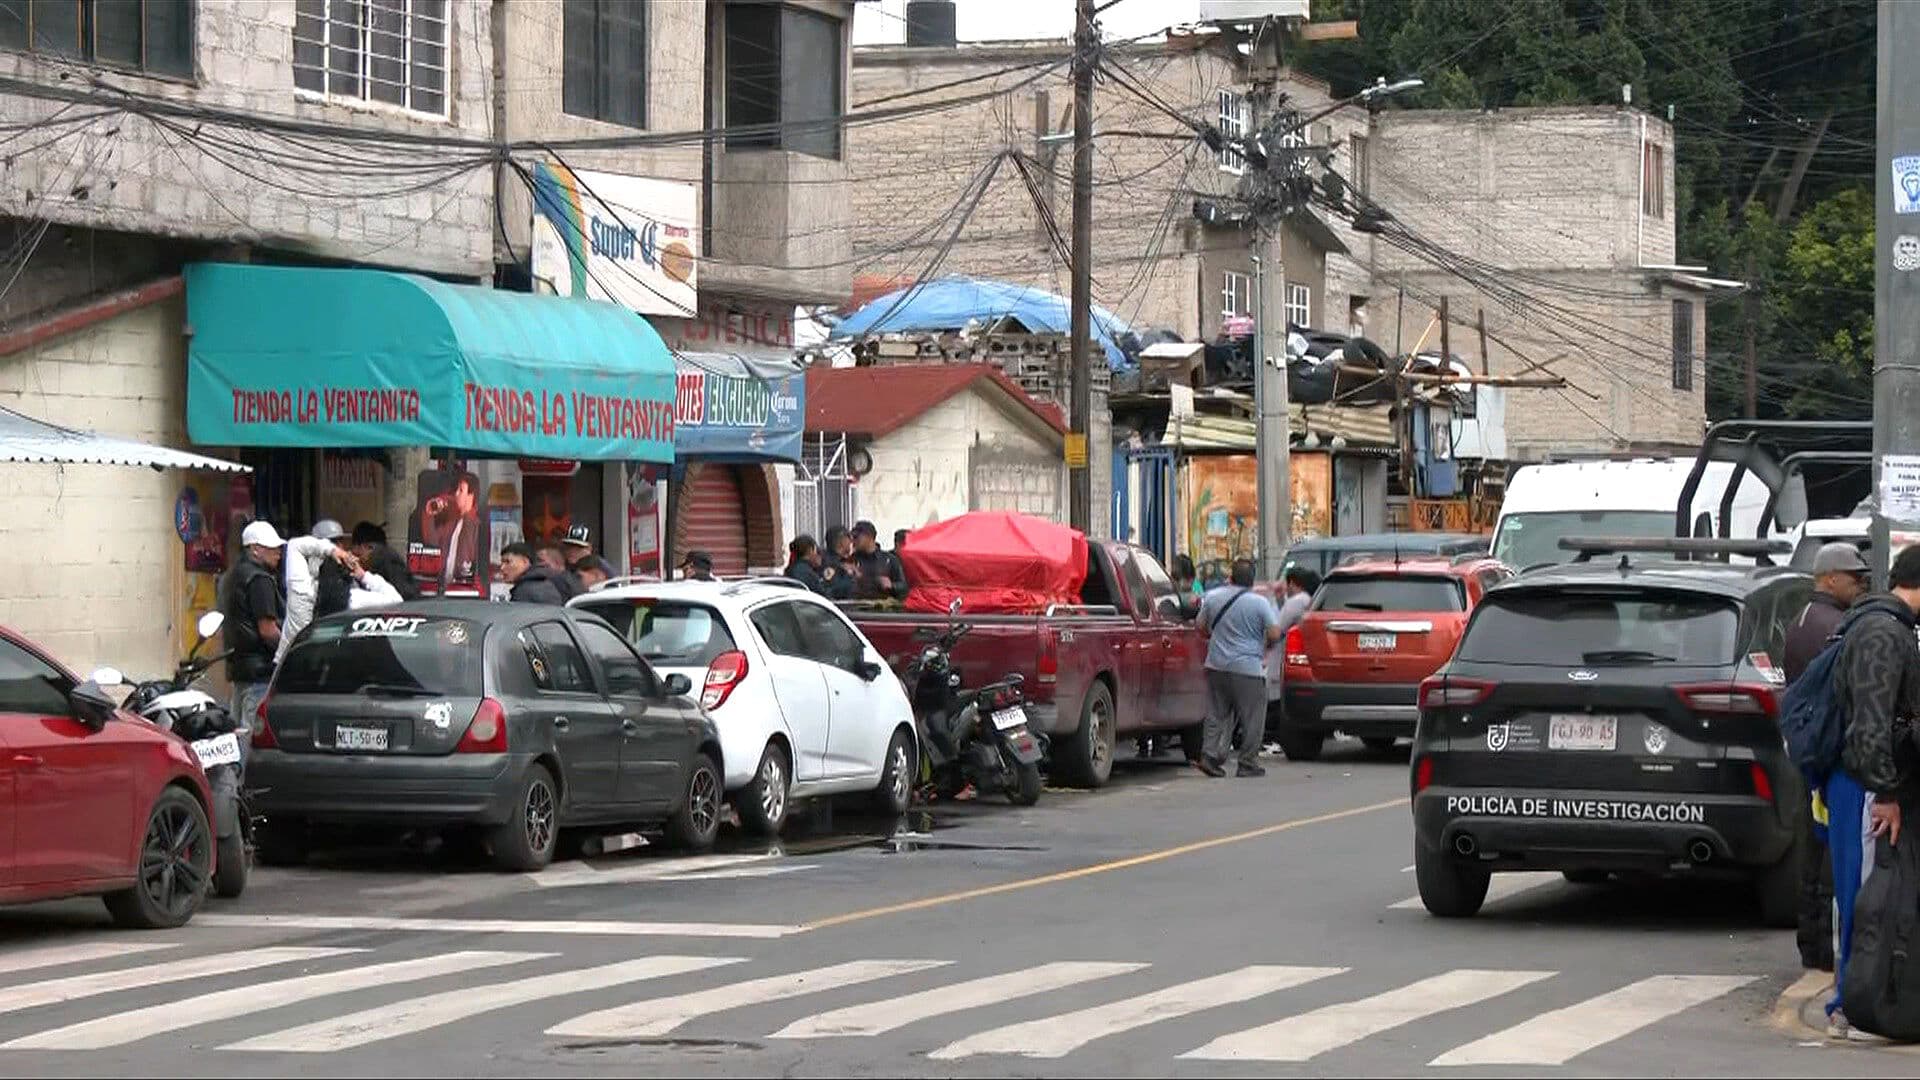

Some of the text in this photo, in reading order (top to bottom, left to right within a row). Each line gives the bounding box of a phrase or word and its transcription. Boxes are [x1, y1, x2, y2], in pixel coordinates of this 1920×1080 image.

[591, 215, 638, 261] Super
[232, 385, 420, 424] TIENDA LA VENTANITA
[464, 383, 675, 444] TIENDA LA VENTANITA
[707, 373, 724, 425] EL
[1447, 795, 1704, 822] POLICÍA DE INVESTIGACIÓN
